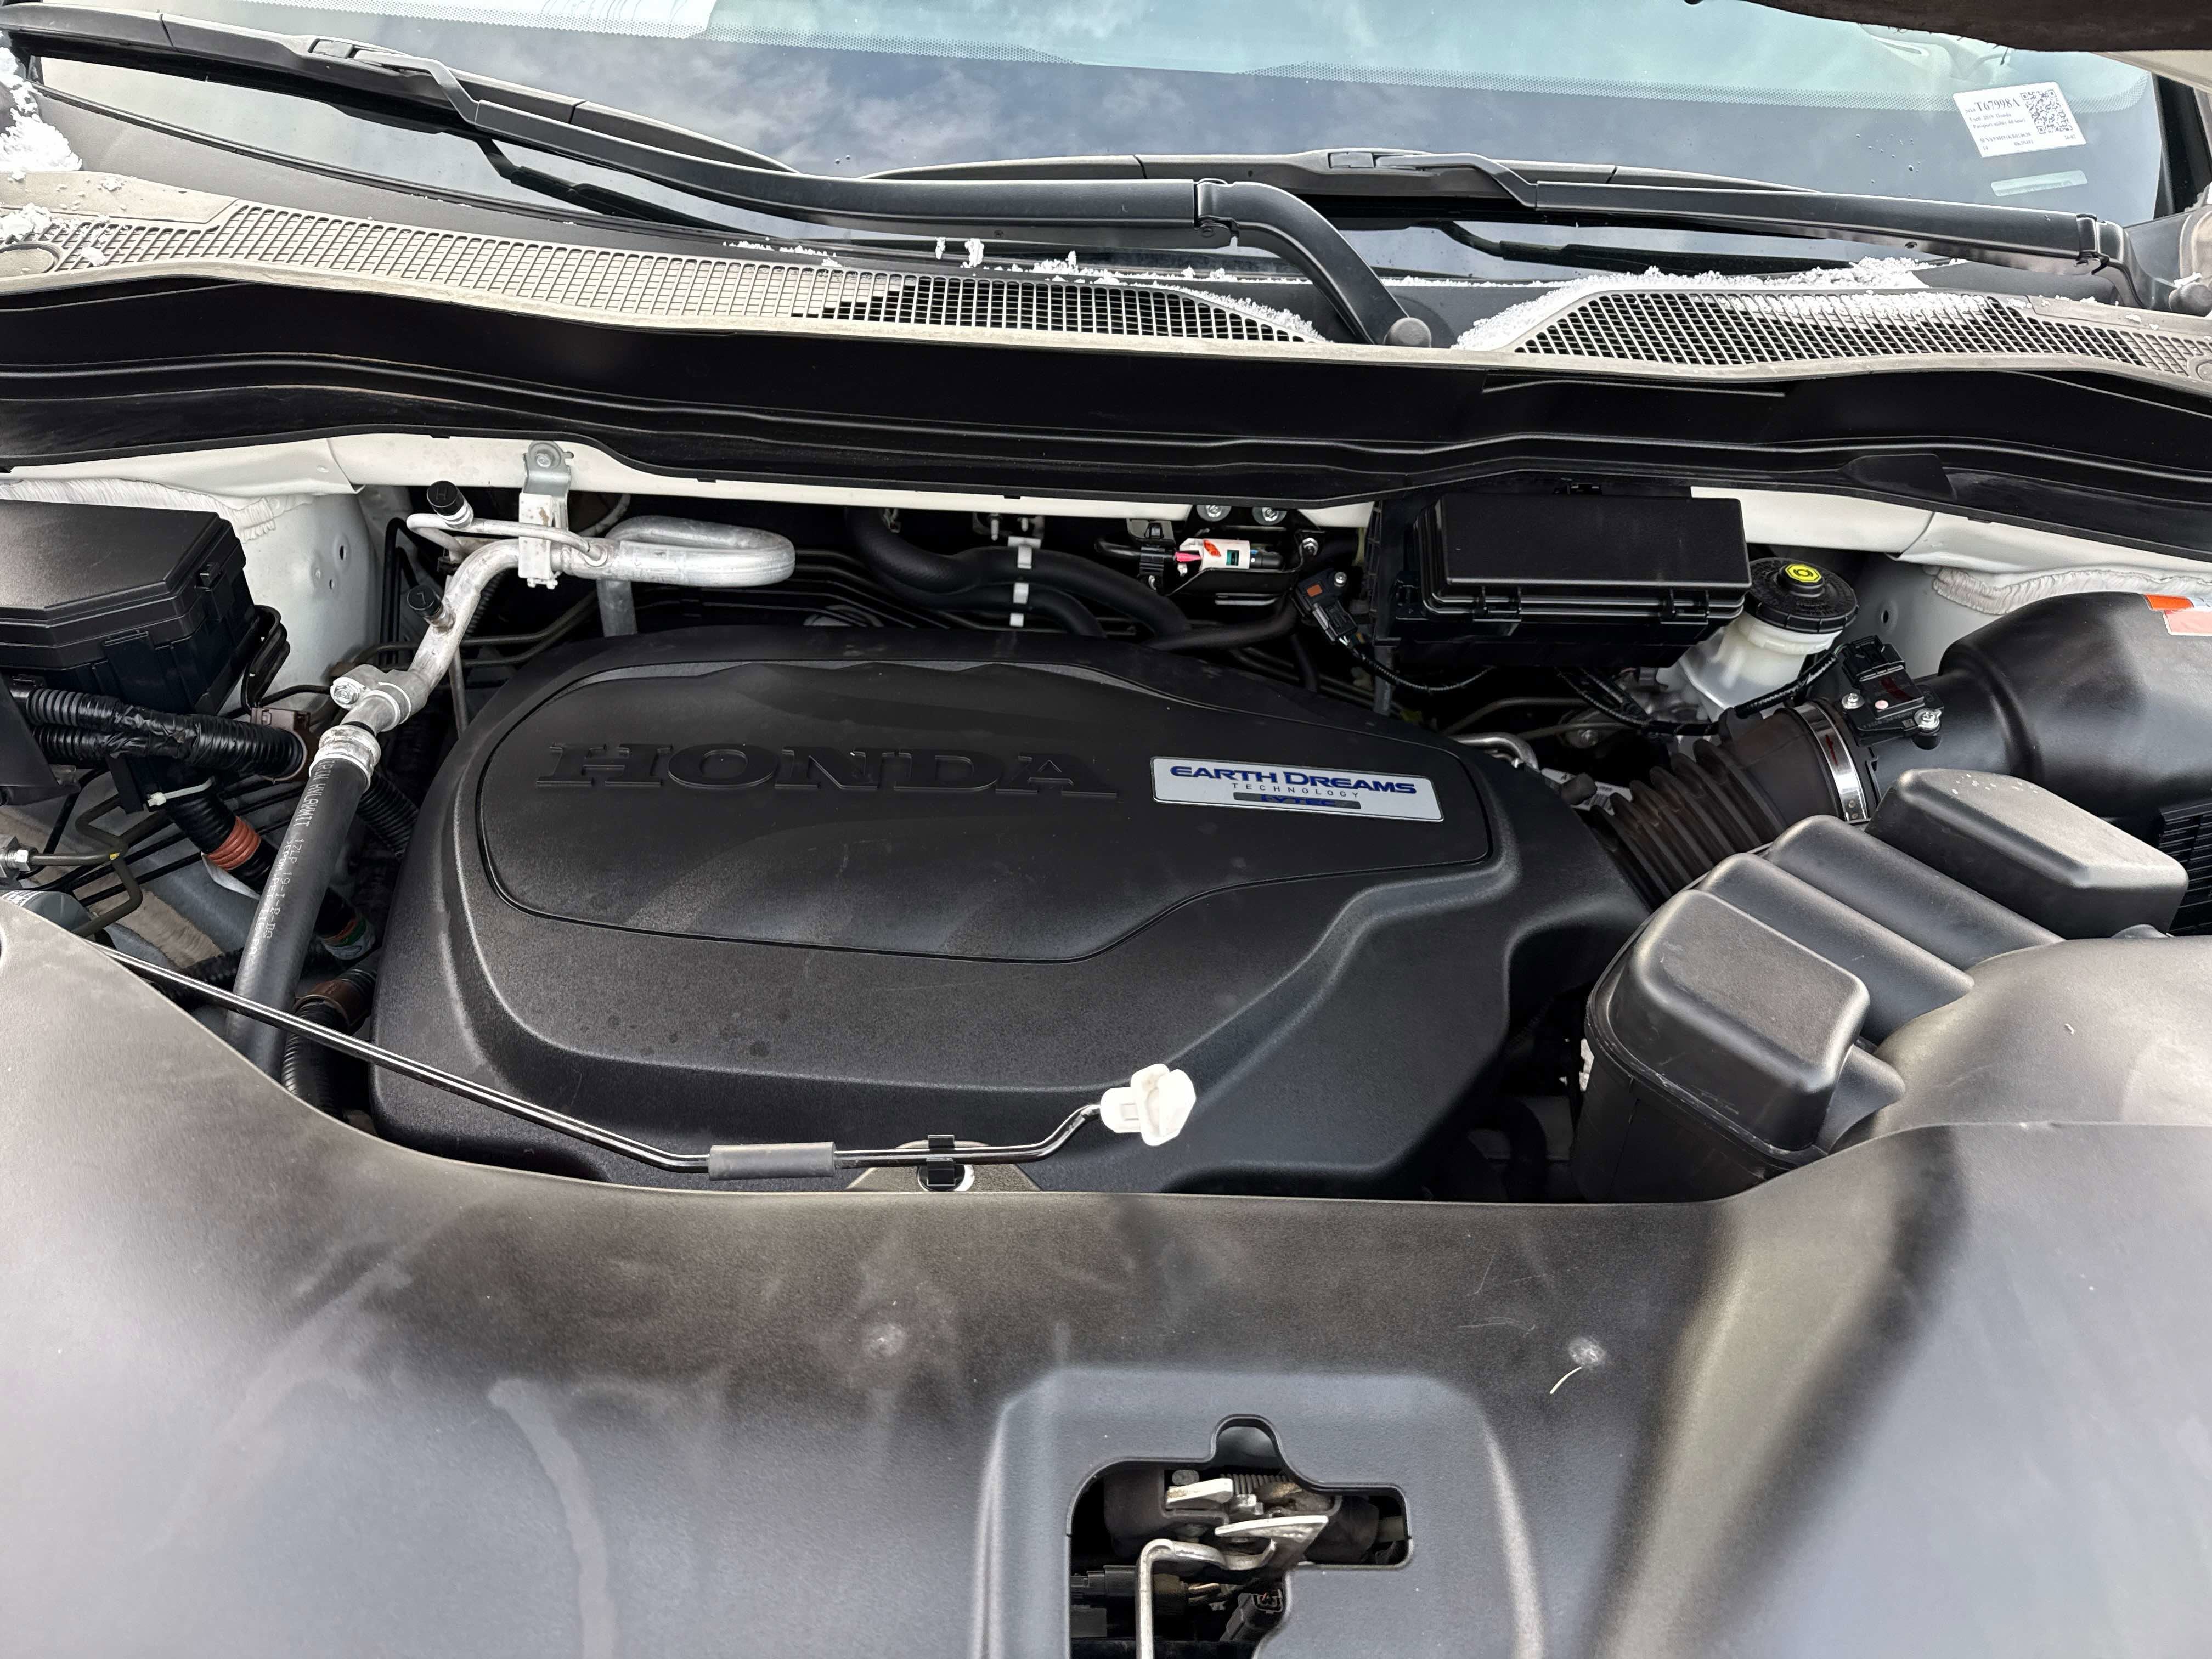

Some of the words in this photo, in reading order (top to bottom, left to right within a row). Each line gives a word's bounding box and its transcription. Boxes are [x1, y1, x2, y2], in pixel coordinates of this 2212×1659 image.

[1974, 98, 2020, 111] T67998A
[436, 487, 447, 501] H
[536, 743, 1118, 798] HONDA
[1170, 766, 1278, 784] EARTH
[1283, 771, 1417, 795] DREAMS
[1233, 783, 1359, 798] TECHNOLOGY
